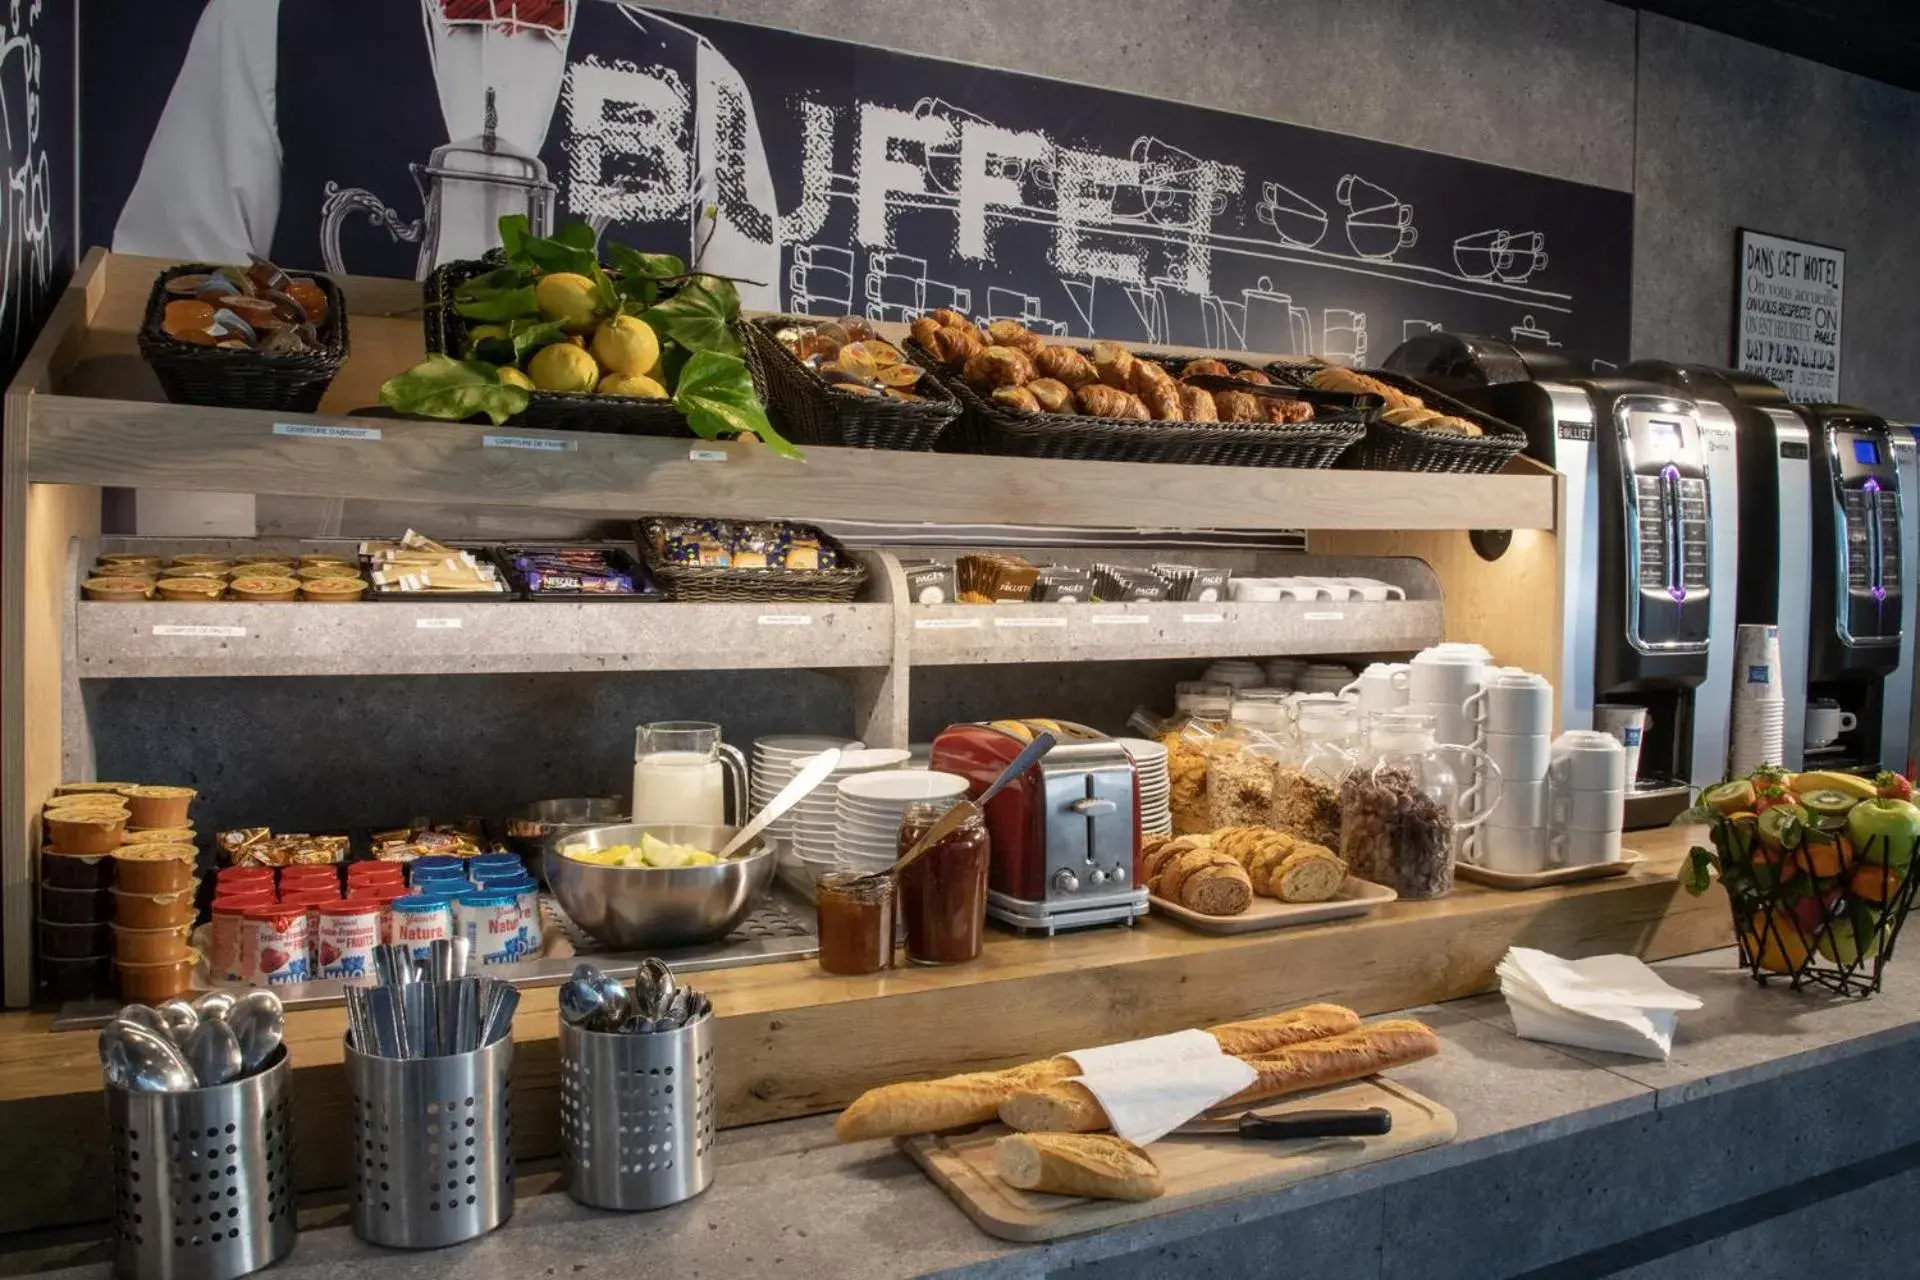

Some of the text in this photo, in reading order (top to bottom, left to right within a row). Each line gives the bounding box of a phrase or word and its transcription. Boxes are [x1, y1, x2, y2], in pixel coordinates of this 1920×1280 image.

[560, 53, 1245, 295] BUFFET
[1747, 243, 1839, 289] DANS CET HOTEL
[1814, 307, 1838, 331] ON
[400, 925, 443, 941] Nature
